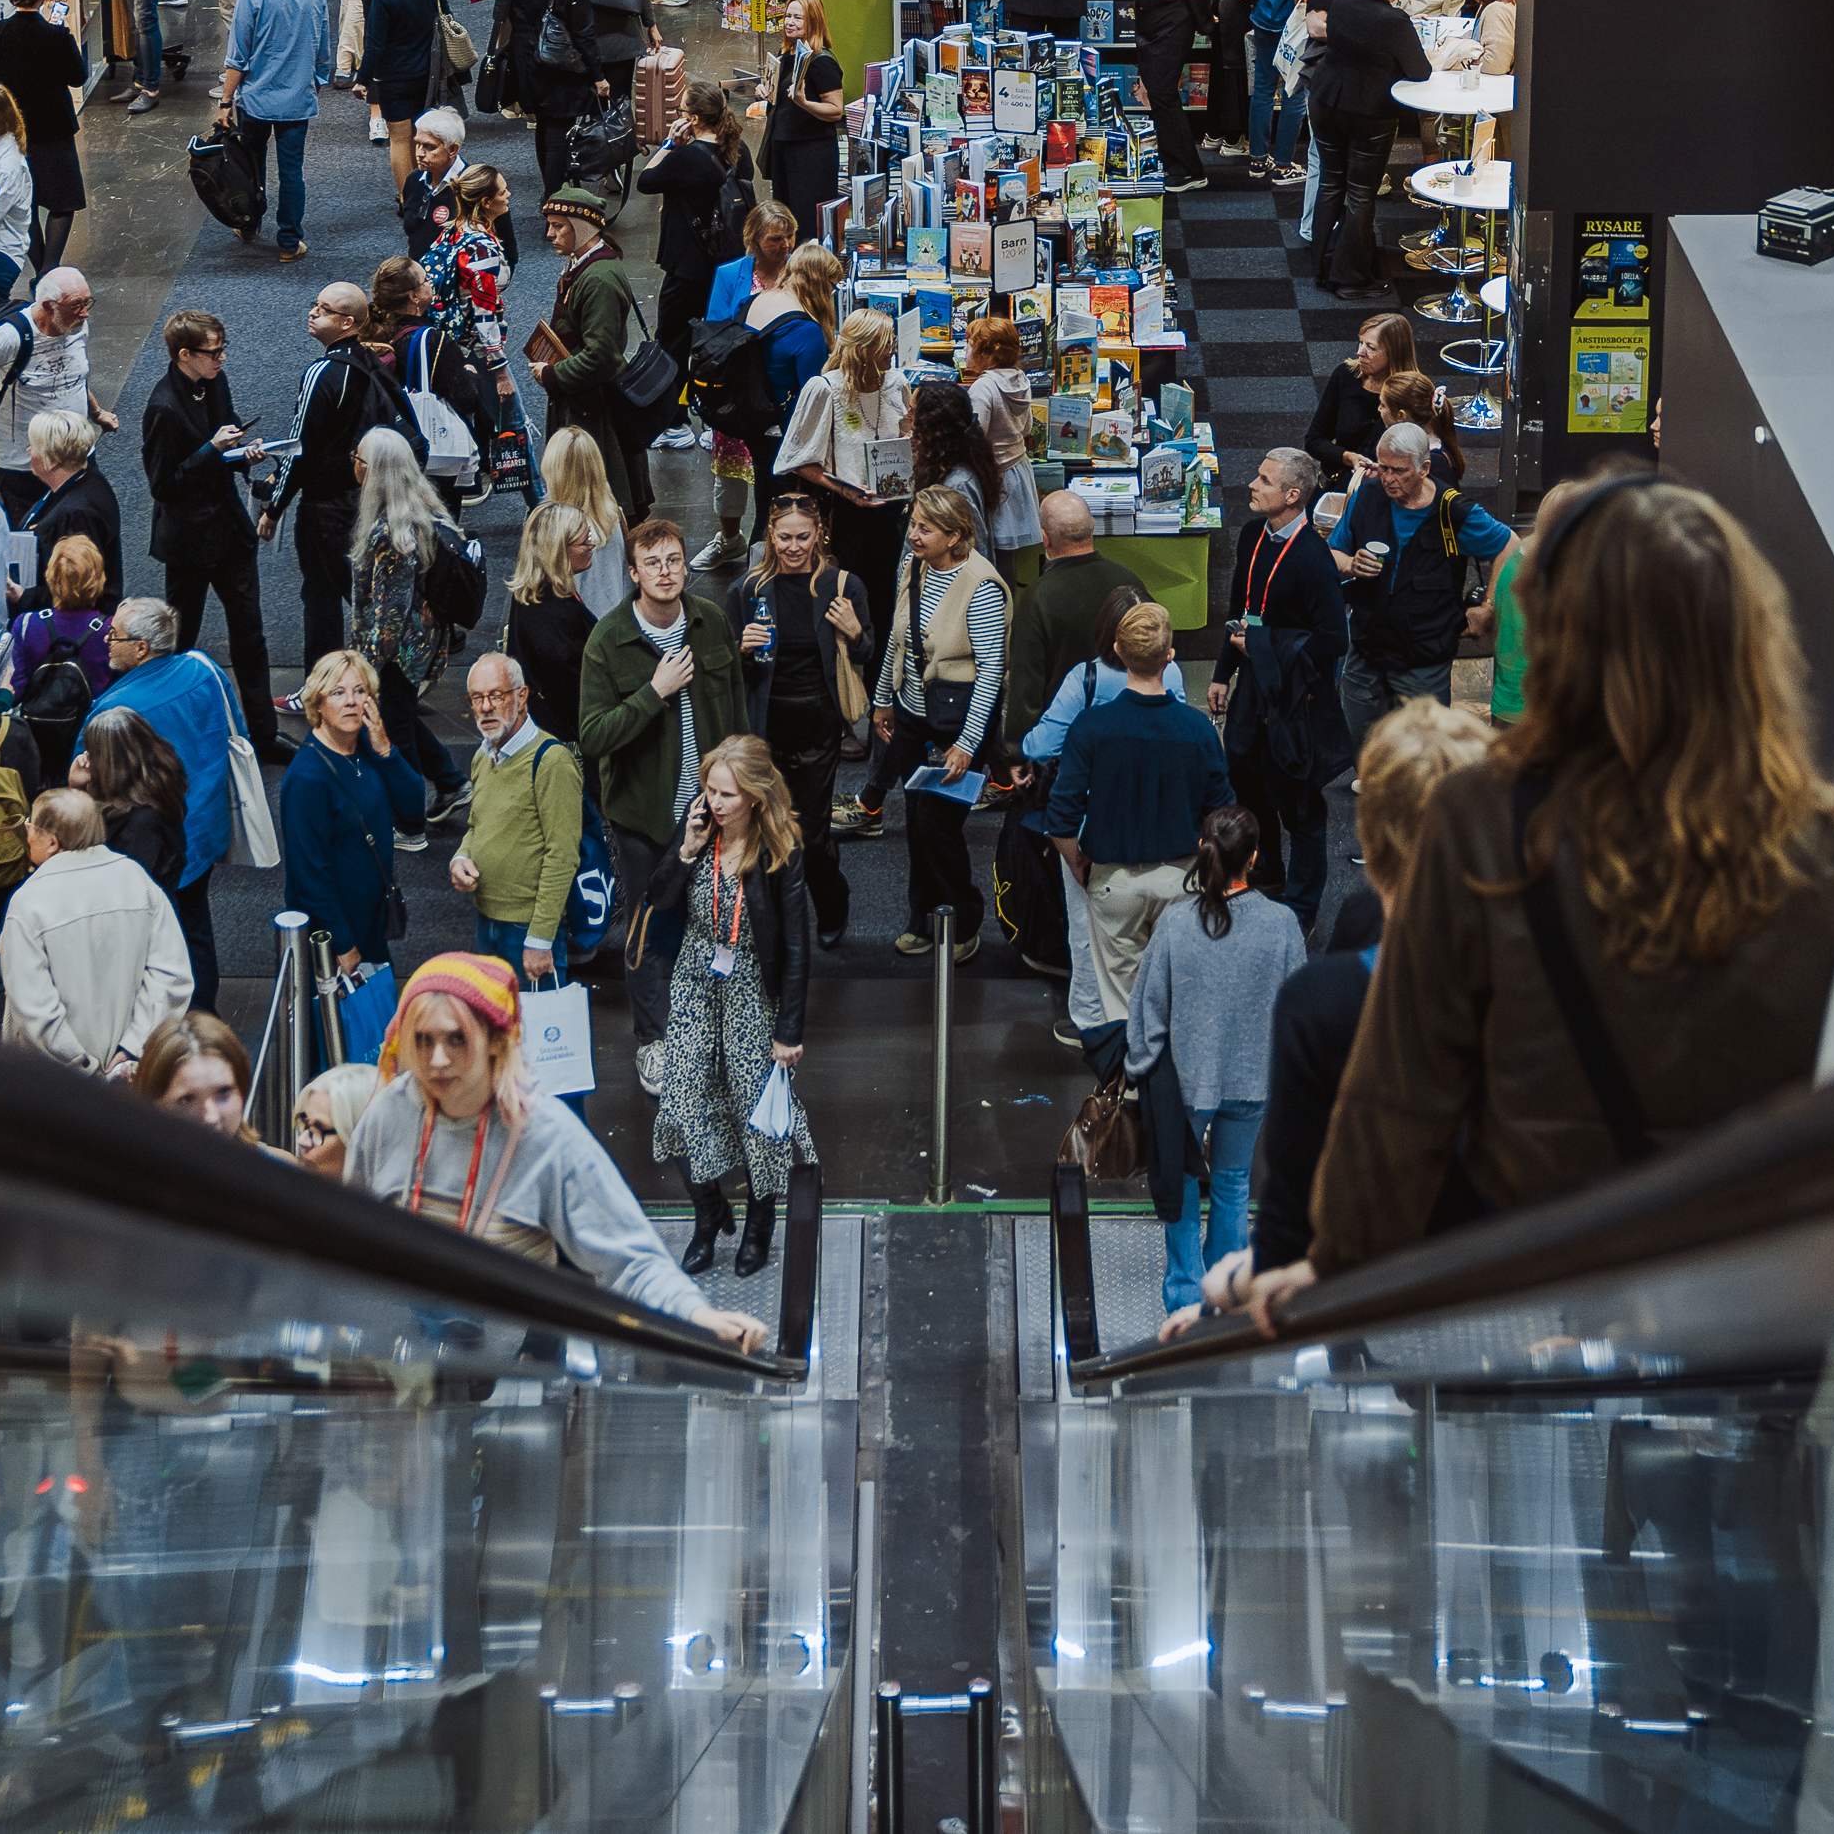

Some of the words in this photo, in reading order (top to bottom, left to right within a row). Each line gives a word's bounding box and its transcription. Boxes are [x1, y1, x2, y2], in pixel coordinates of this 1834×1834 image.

[1586, 220, 1642, 232] RYSARE
[1001, 238, 1027, 250] Barn
[1002, 249, 1017, 259] 120
[1018, 248, 1027, 257] kr
